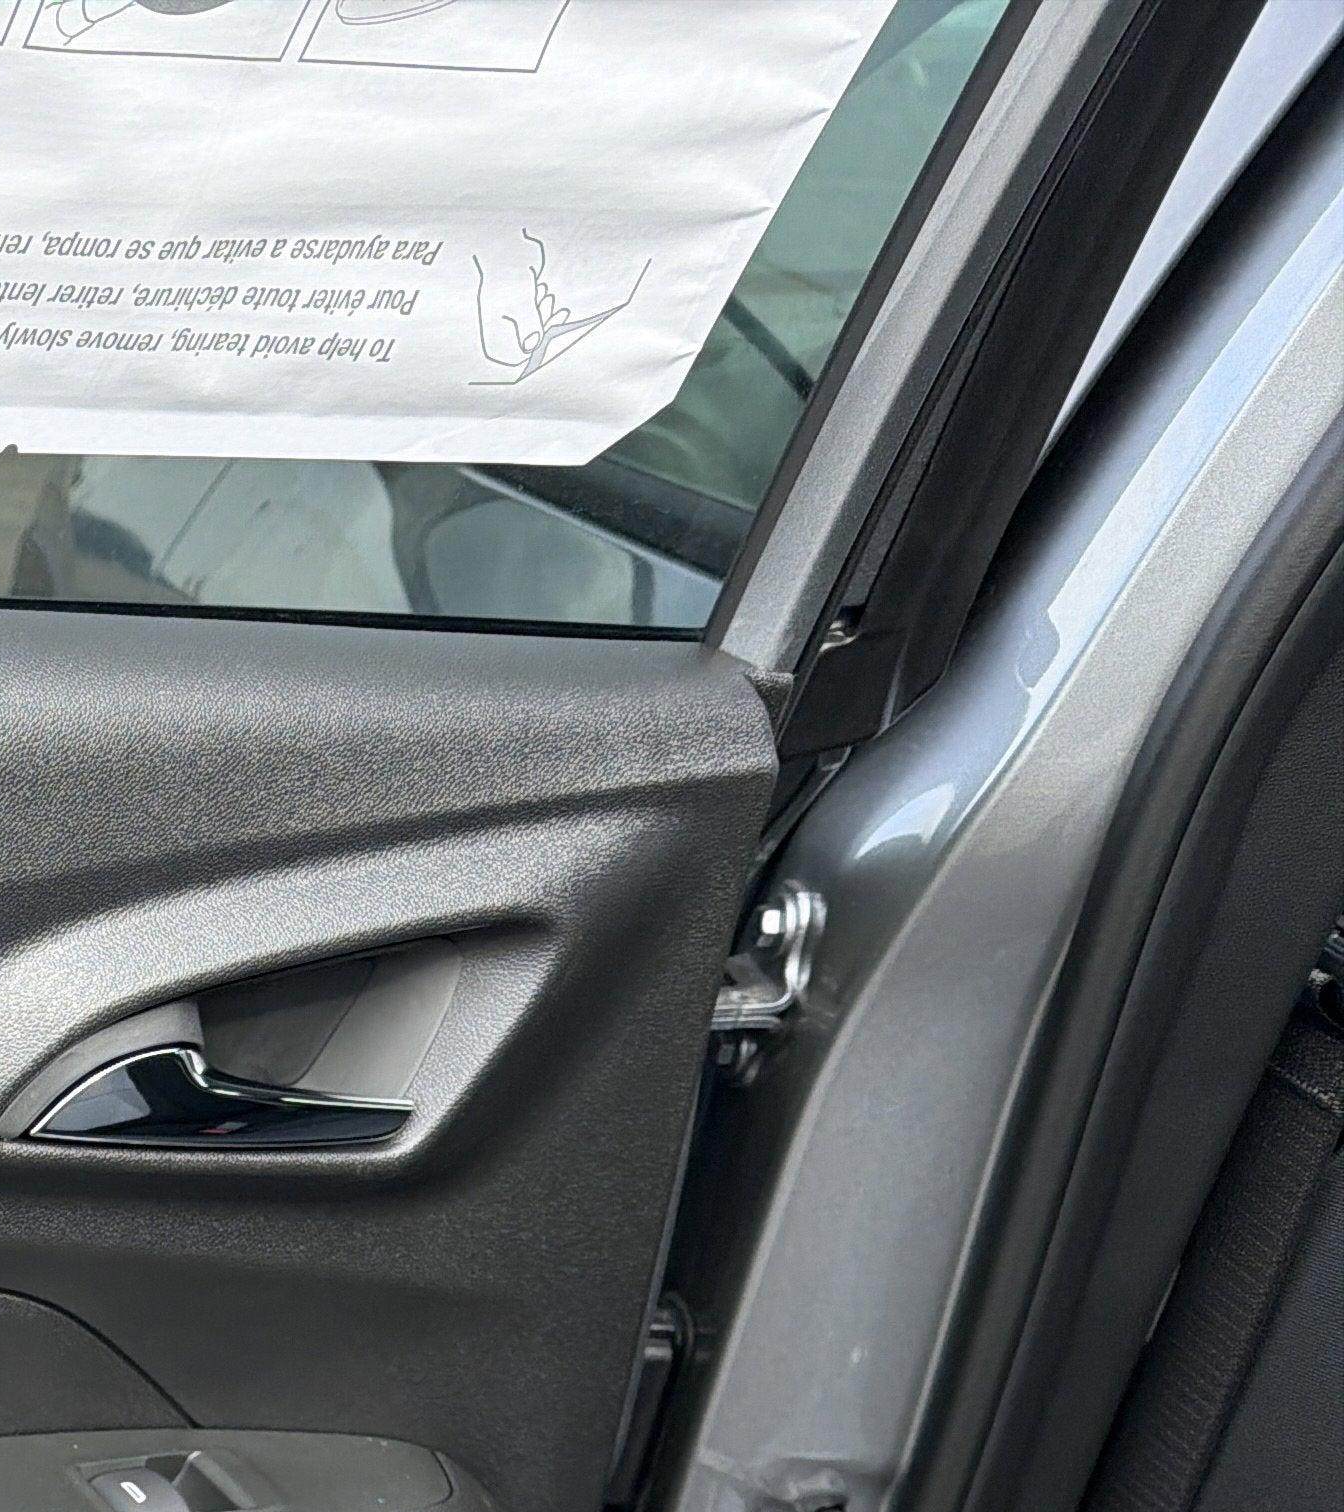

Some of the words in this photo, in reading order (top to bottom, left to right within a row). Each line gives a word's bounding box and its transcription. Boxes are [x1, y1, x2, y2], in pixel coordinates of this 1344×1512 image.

[41, 230, 123, 259] rompa,
[124, 239, 156, 260] se
[158, 234, 202, 260] que
[202, 238, 268, 265] evitar
[269, 238, 288, 259] a
[290, 234, 391, 266] ayudarse
[392, 240, 445, 266] Para
[45, 284, 125, 310] retirer
[132, 282, 239, 312] déchirure,
[242, 286, 302, 313] toute
[302, 288, 366, 317] éviter
[367, 289, 421, 316] Pour
[75, 330, 165, 352] remove
[170, 327, 251, 357] tearing,
[249, 334, 316, 360] avoid
[317, 331, 368, 362] help
[369, 338, 396, 362] To
